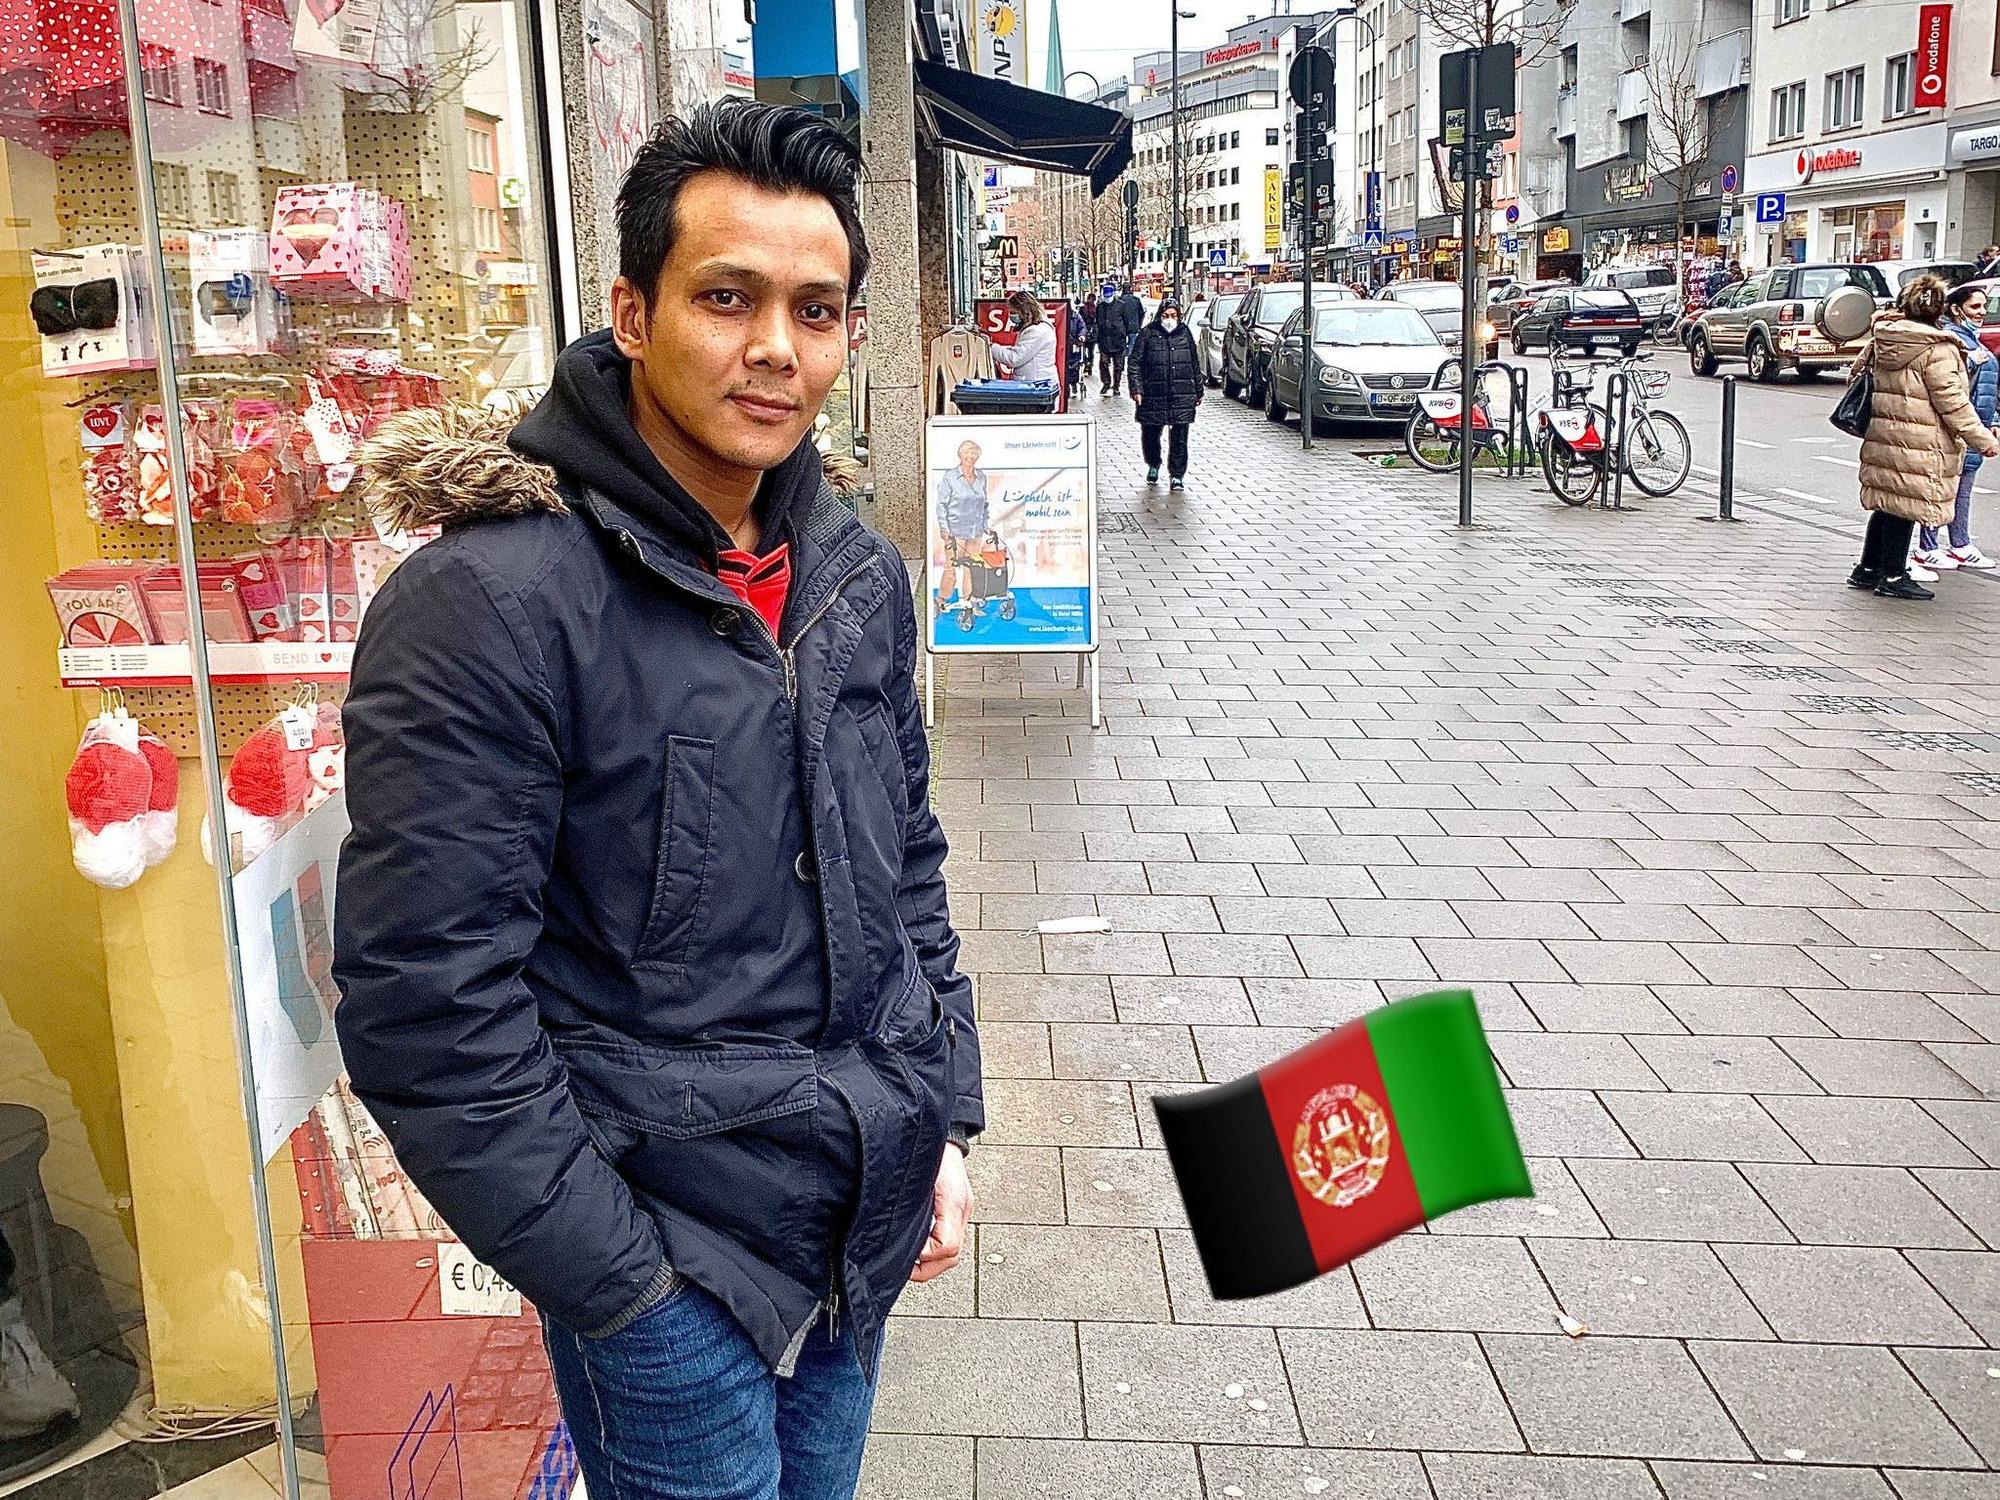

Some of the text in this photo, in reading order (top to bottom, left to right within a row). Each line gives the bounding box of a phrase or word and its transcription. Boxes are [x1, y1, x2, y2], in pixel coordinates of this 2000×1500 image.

[1928, 16, 1941, 72] vodafone
[1268, 182, 1277, 225] AKSU
[1763, 198, 1779, 220] P
[90, 417, 112, 428] LOVE
[1025, 504, 1051, 517] mobil
[64, 596, 92, 613] YOU
[273, 653, 309, 664] SEND
[472, 1263, 515, 1297] 0,4
